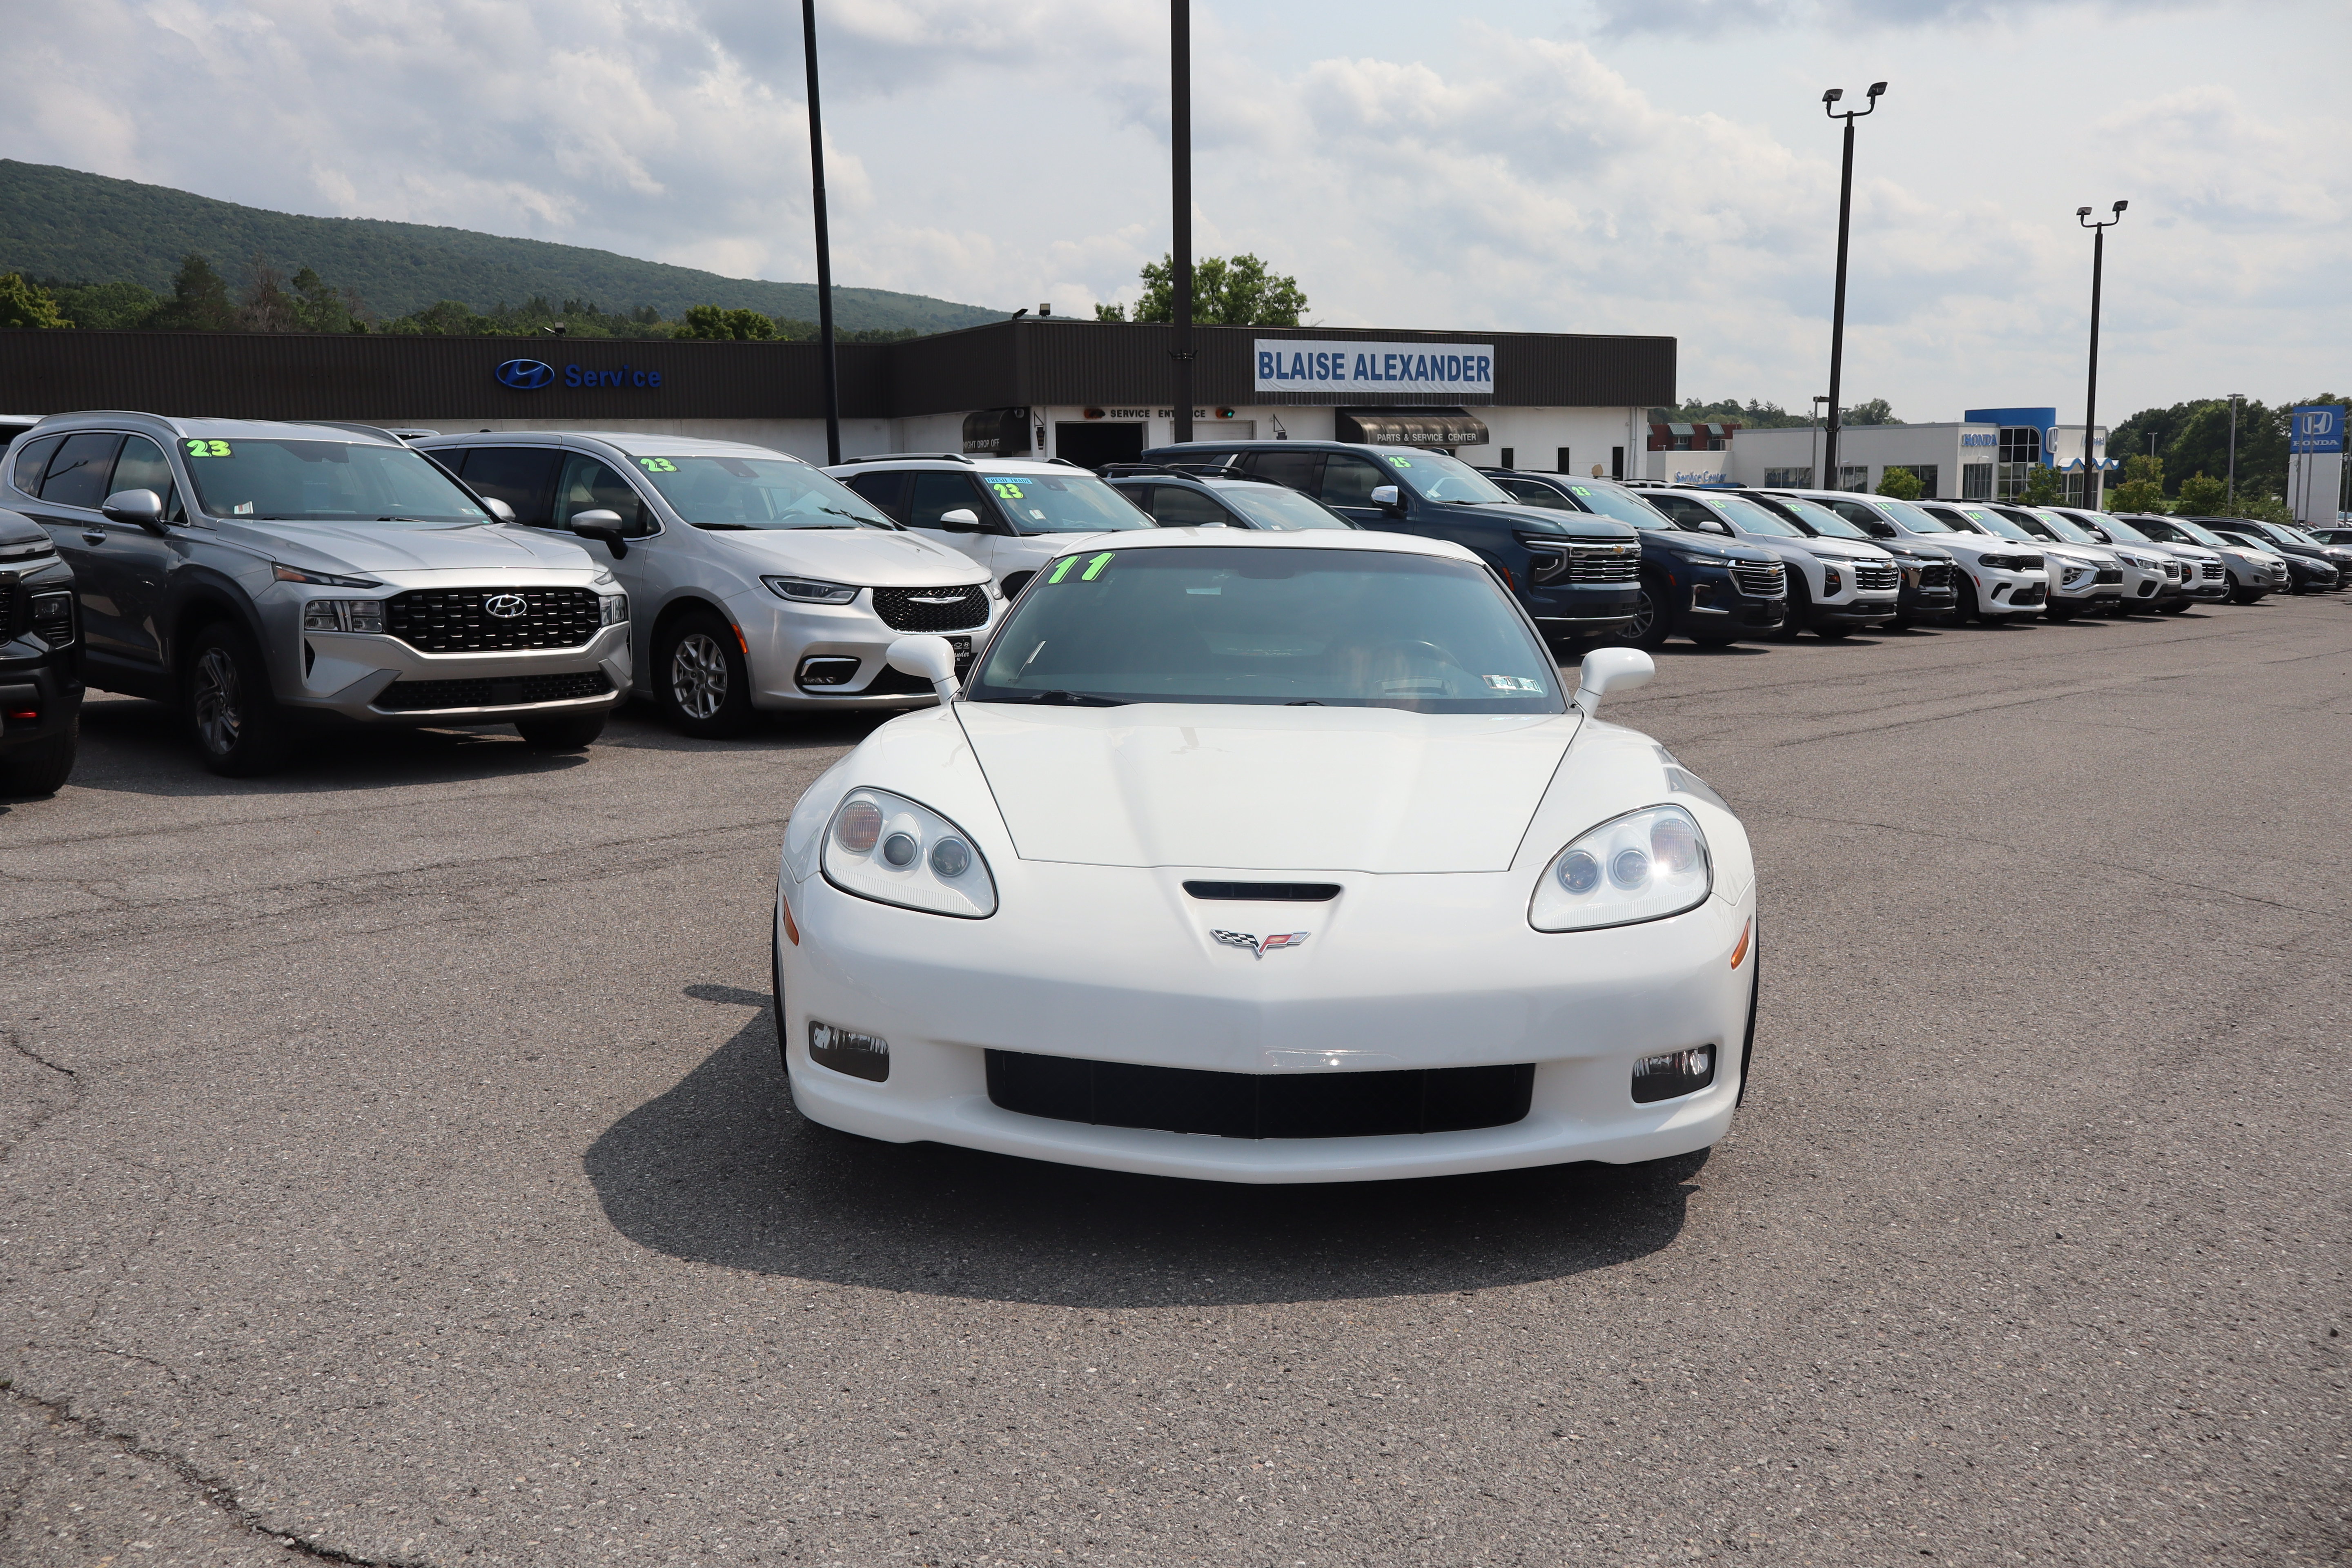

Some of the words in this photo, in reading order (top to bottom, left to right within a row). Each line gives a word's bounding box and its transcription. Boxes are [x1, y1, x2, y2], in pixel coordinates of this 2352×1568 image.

[1258, 351, 1345, 380] BLAISE
[1353, 353, 1491, 382] ALEXANDER
[565, 364, 662, 388] Service
[1110, 410, 1150, 418] SERVICE
[1158, 410, 1205, 418] ENTCE
[1412, 433, 1443, 441] SERVICE
[1448, 433, 1477, 441] CENTER
[1962, 434, 1998, 446] HONDA
[186, 440, 231, 457] 23
[963, 440, 976, 449] NIGHT
[977, 439, 989, 448] DROP
[991, 438, 1000, 447] OFF
[640, 458, 677, 472] 23
[1389, 457, 1412, 468] 25
[1675, 471, 1702, 482] Service
[1702, 470, 1726, 482] Center
[993, 483, 1024, 499] 23
[1571, 486, 1592, 496] 23
[1709, 500, 1726, 508] 25
[1048, 552, 1116, 584] 11
